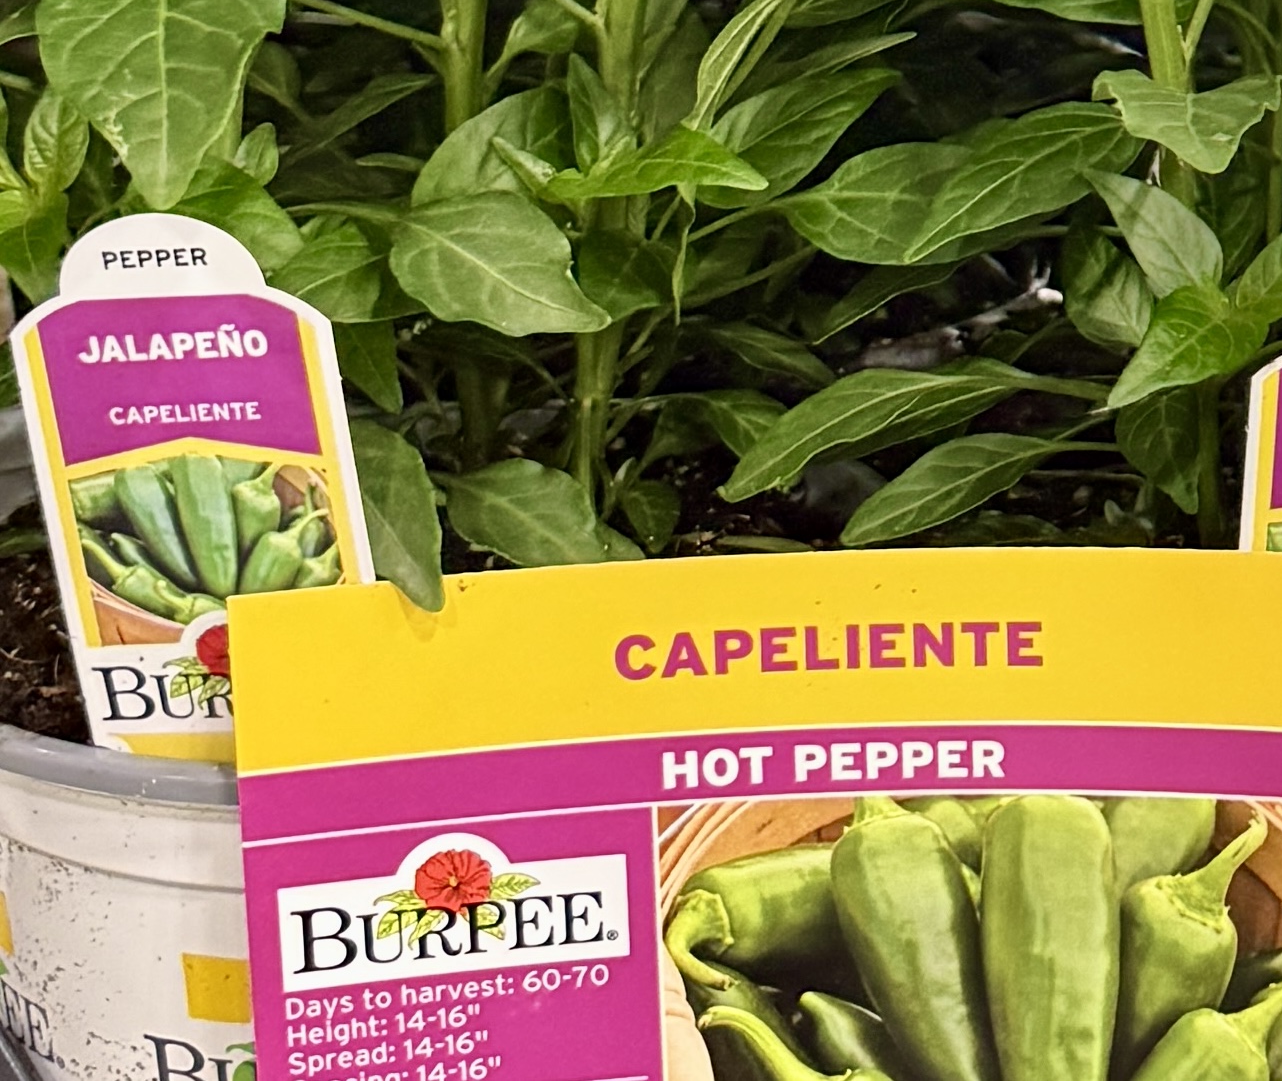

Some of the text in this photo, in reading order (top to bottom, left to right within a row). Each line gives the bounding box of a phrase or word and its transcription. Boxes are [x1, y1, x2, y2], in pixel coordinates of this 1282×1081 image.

[101, 246, 209, 271] PEPPER
[77, 323, 269, 365] JALAPEÑO
[108, 400, 262, 426] CAPELIENTE
[613, 620, 1045, 682] CAPELIENTE
[91, 664, 235, 722] BUR
[661, 739, 1007, 791] HOT PEPPER
[284, 963, 610, 1021] Days to harvest: 60-70
[286, 1002, 482, 1048] Height: 14-16"
[288, 1043, 397, 1078] Spread:
[402, 1029, 490, 1061] 14-16"
